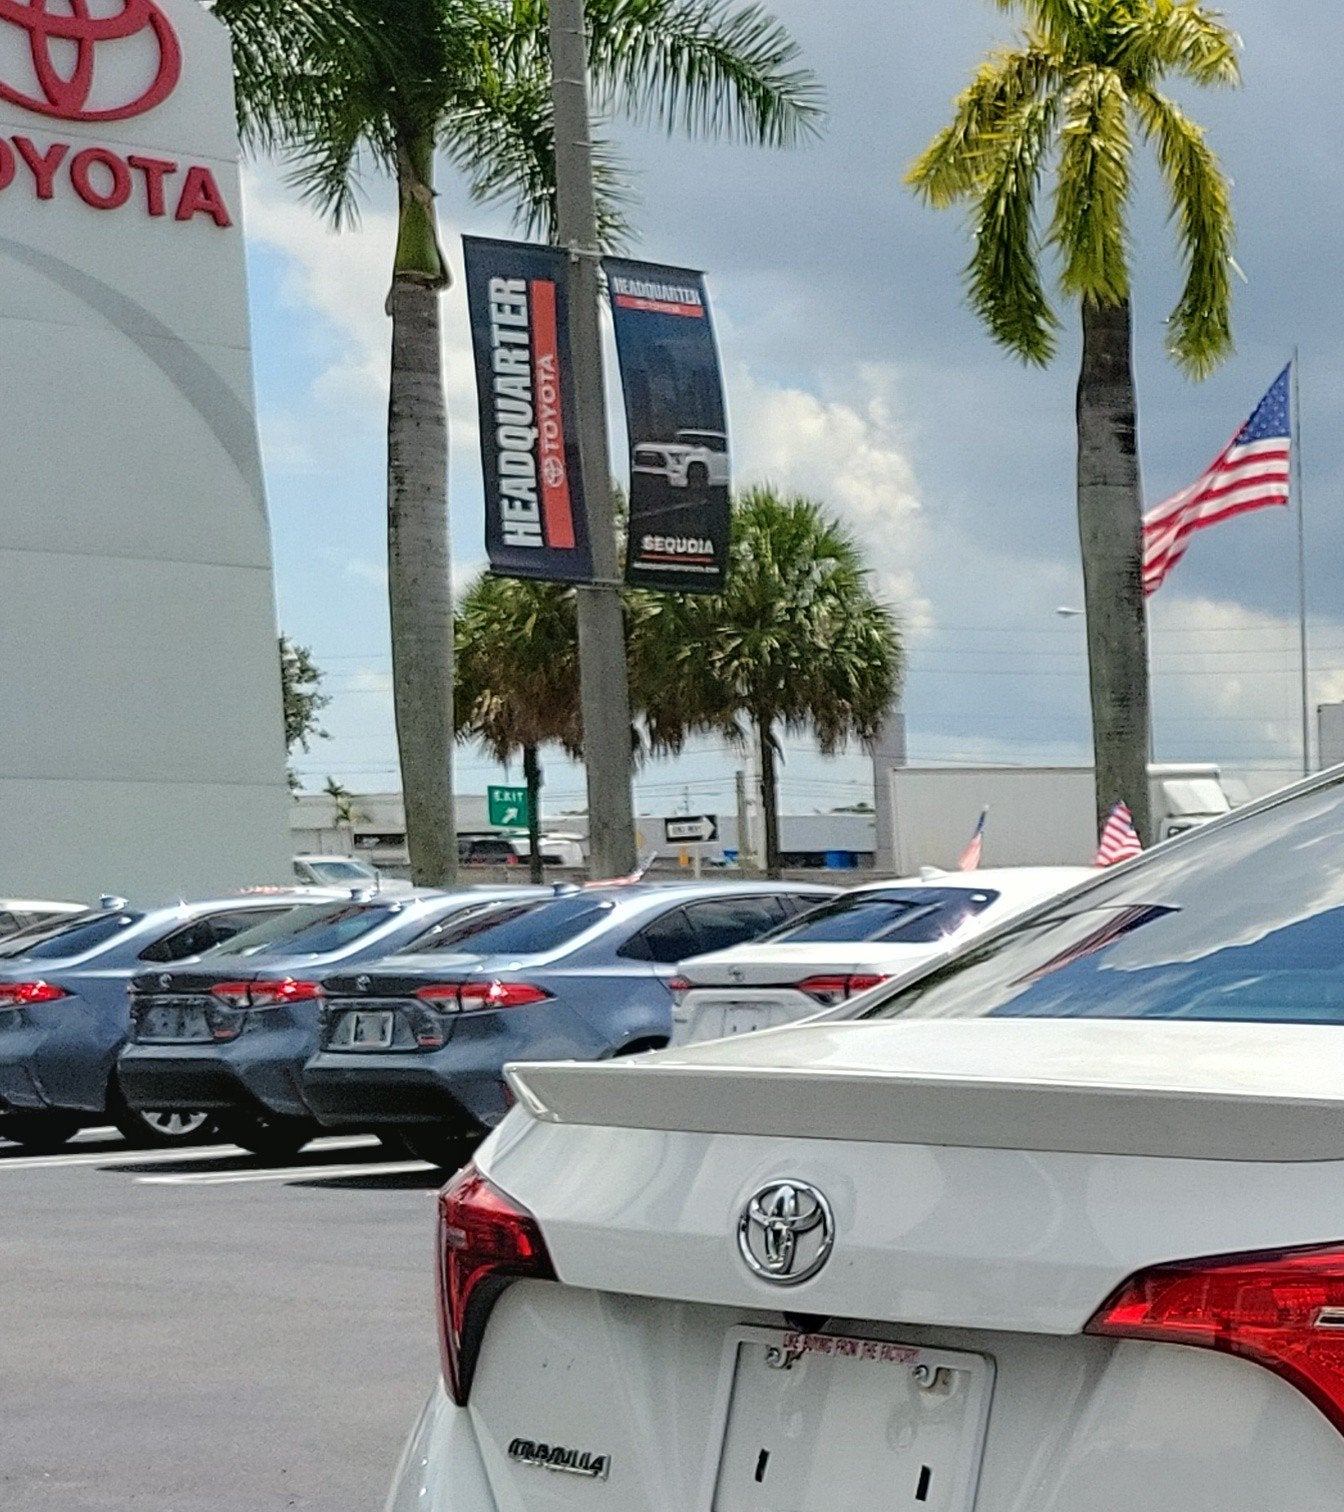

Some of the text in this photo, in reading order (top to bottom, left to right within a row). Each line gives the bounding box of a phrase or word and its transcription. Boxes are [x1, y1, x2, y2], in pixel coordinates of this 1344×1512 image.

[0, 135, 233, 228] YOTA
[489, 276, 545, 548] HEADQUARTER
[537, 353, 560, 452] TOYOTA
[641, 534, 714, 555] SEQUOIA
[494, 790, 523, 802] EXIT
